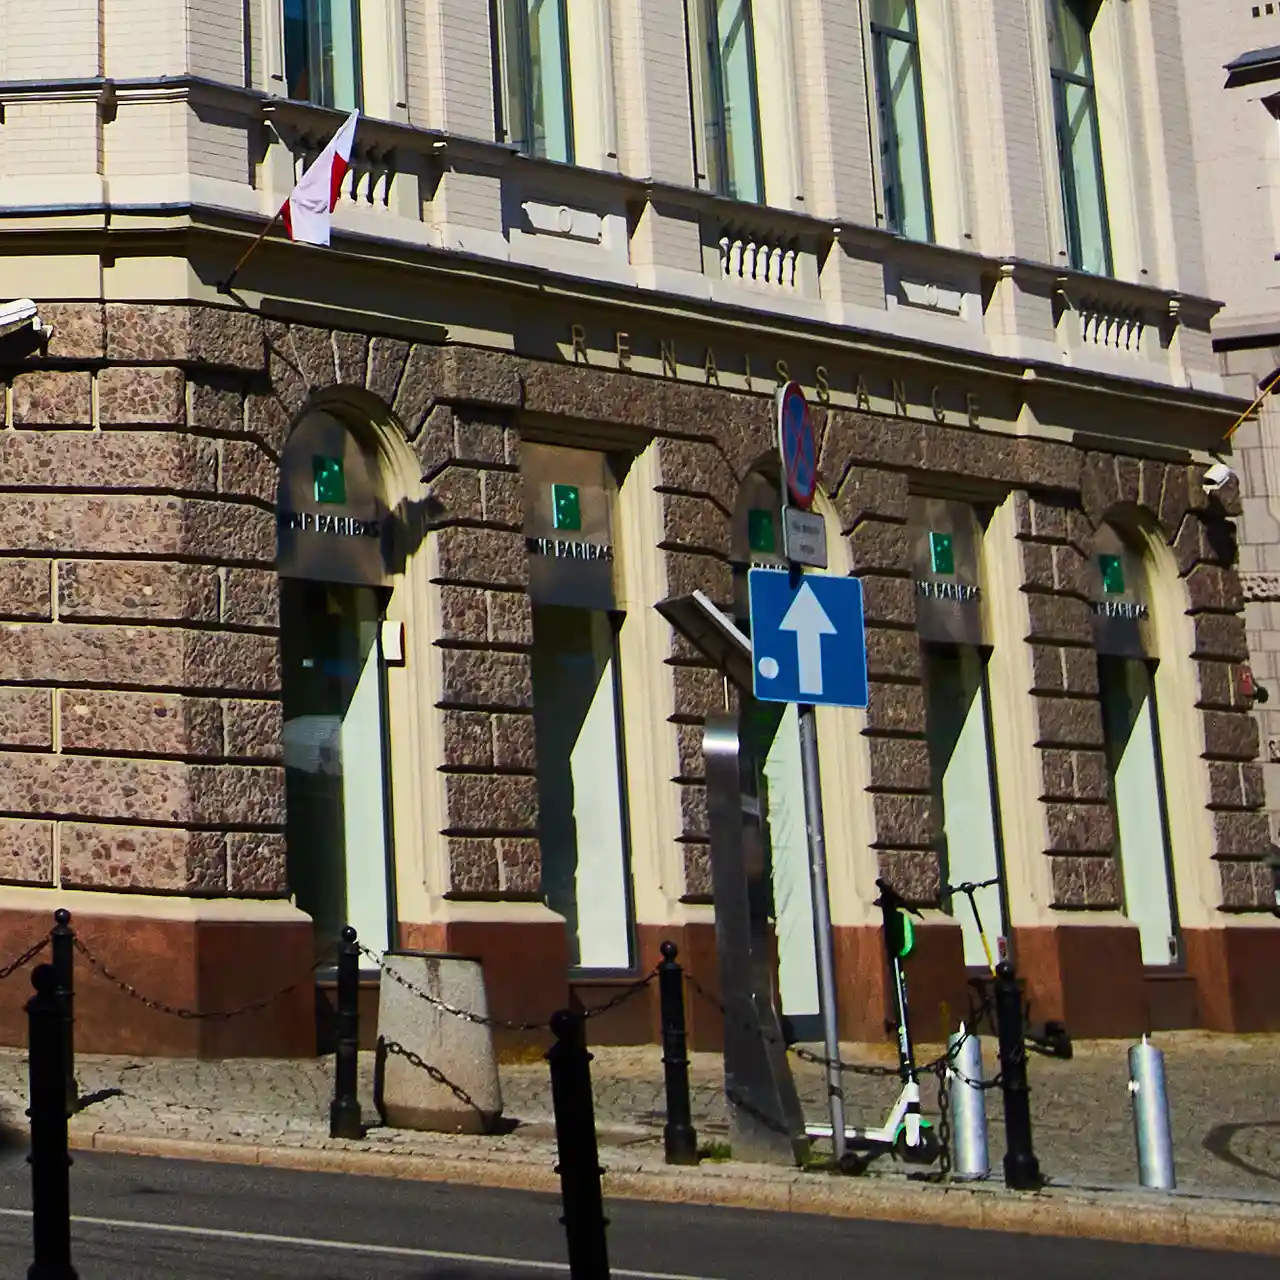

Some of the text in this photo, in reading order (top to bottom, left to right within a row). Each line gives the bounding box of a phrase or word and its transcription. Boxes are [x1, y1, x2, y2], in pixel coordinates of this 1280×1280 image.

[571, 323, 981, 429] RENAISSANCE
[315, 512, 380, 538] PARIBAS
[555, 538, 613, 561] PARIBAS
